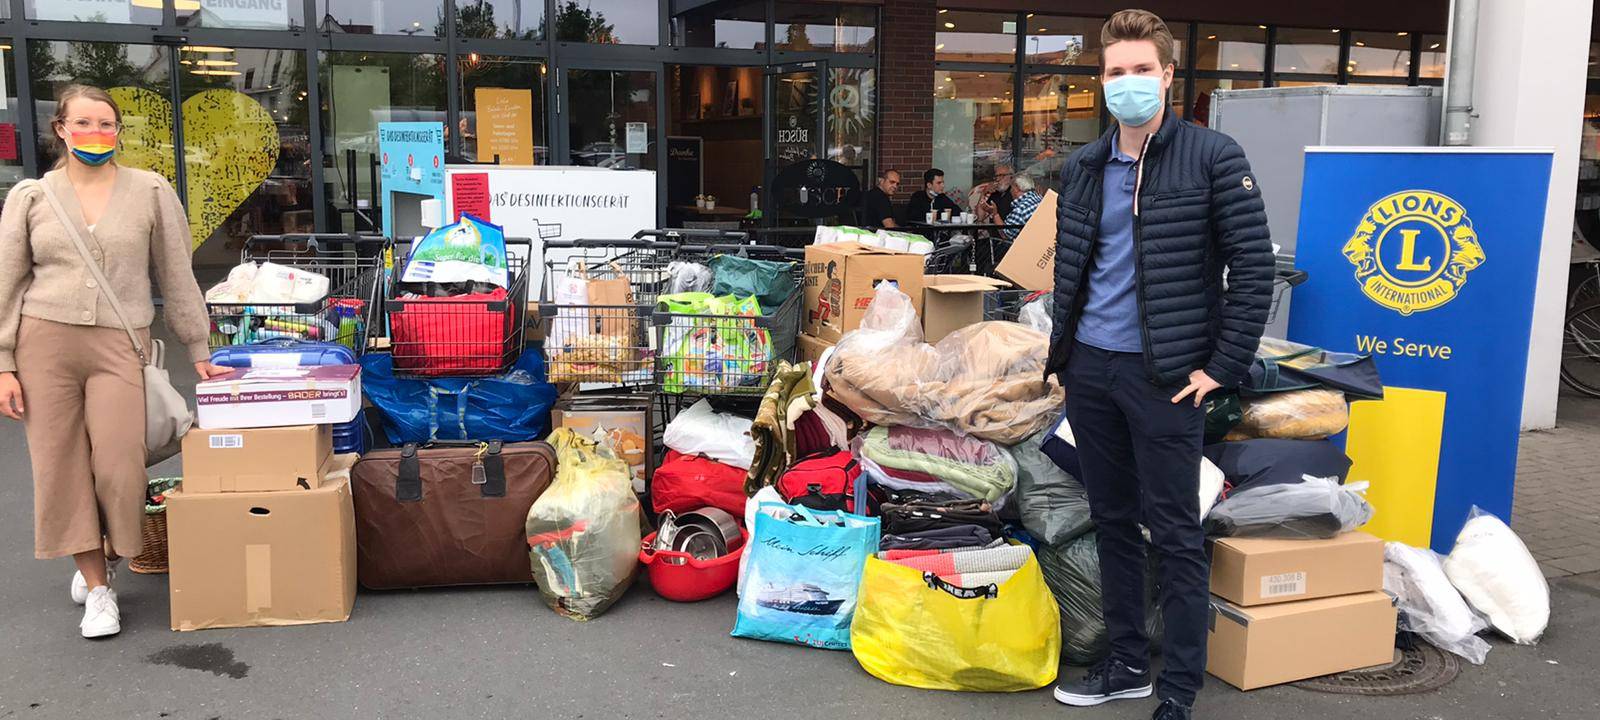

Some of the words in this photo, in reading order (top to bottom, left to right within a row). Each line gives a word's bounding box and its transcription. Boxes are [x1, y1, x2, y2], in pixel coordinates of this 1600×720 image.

[206, 0, 282, 10] EINGANG
[1378, 196, 1457, 223] LIONS
[1396, 229, 1431, 271] L
[1370, 280, 1448, 304] INTERNATIONAL
[1356, 335, 1387, 354] We
[1392, 338, 1452, 359] Serve
[288, 390, 321, 399] BADER
[761, 537, 794, 553] Mein
[798, 544, 852, 561] Schiff
